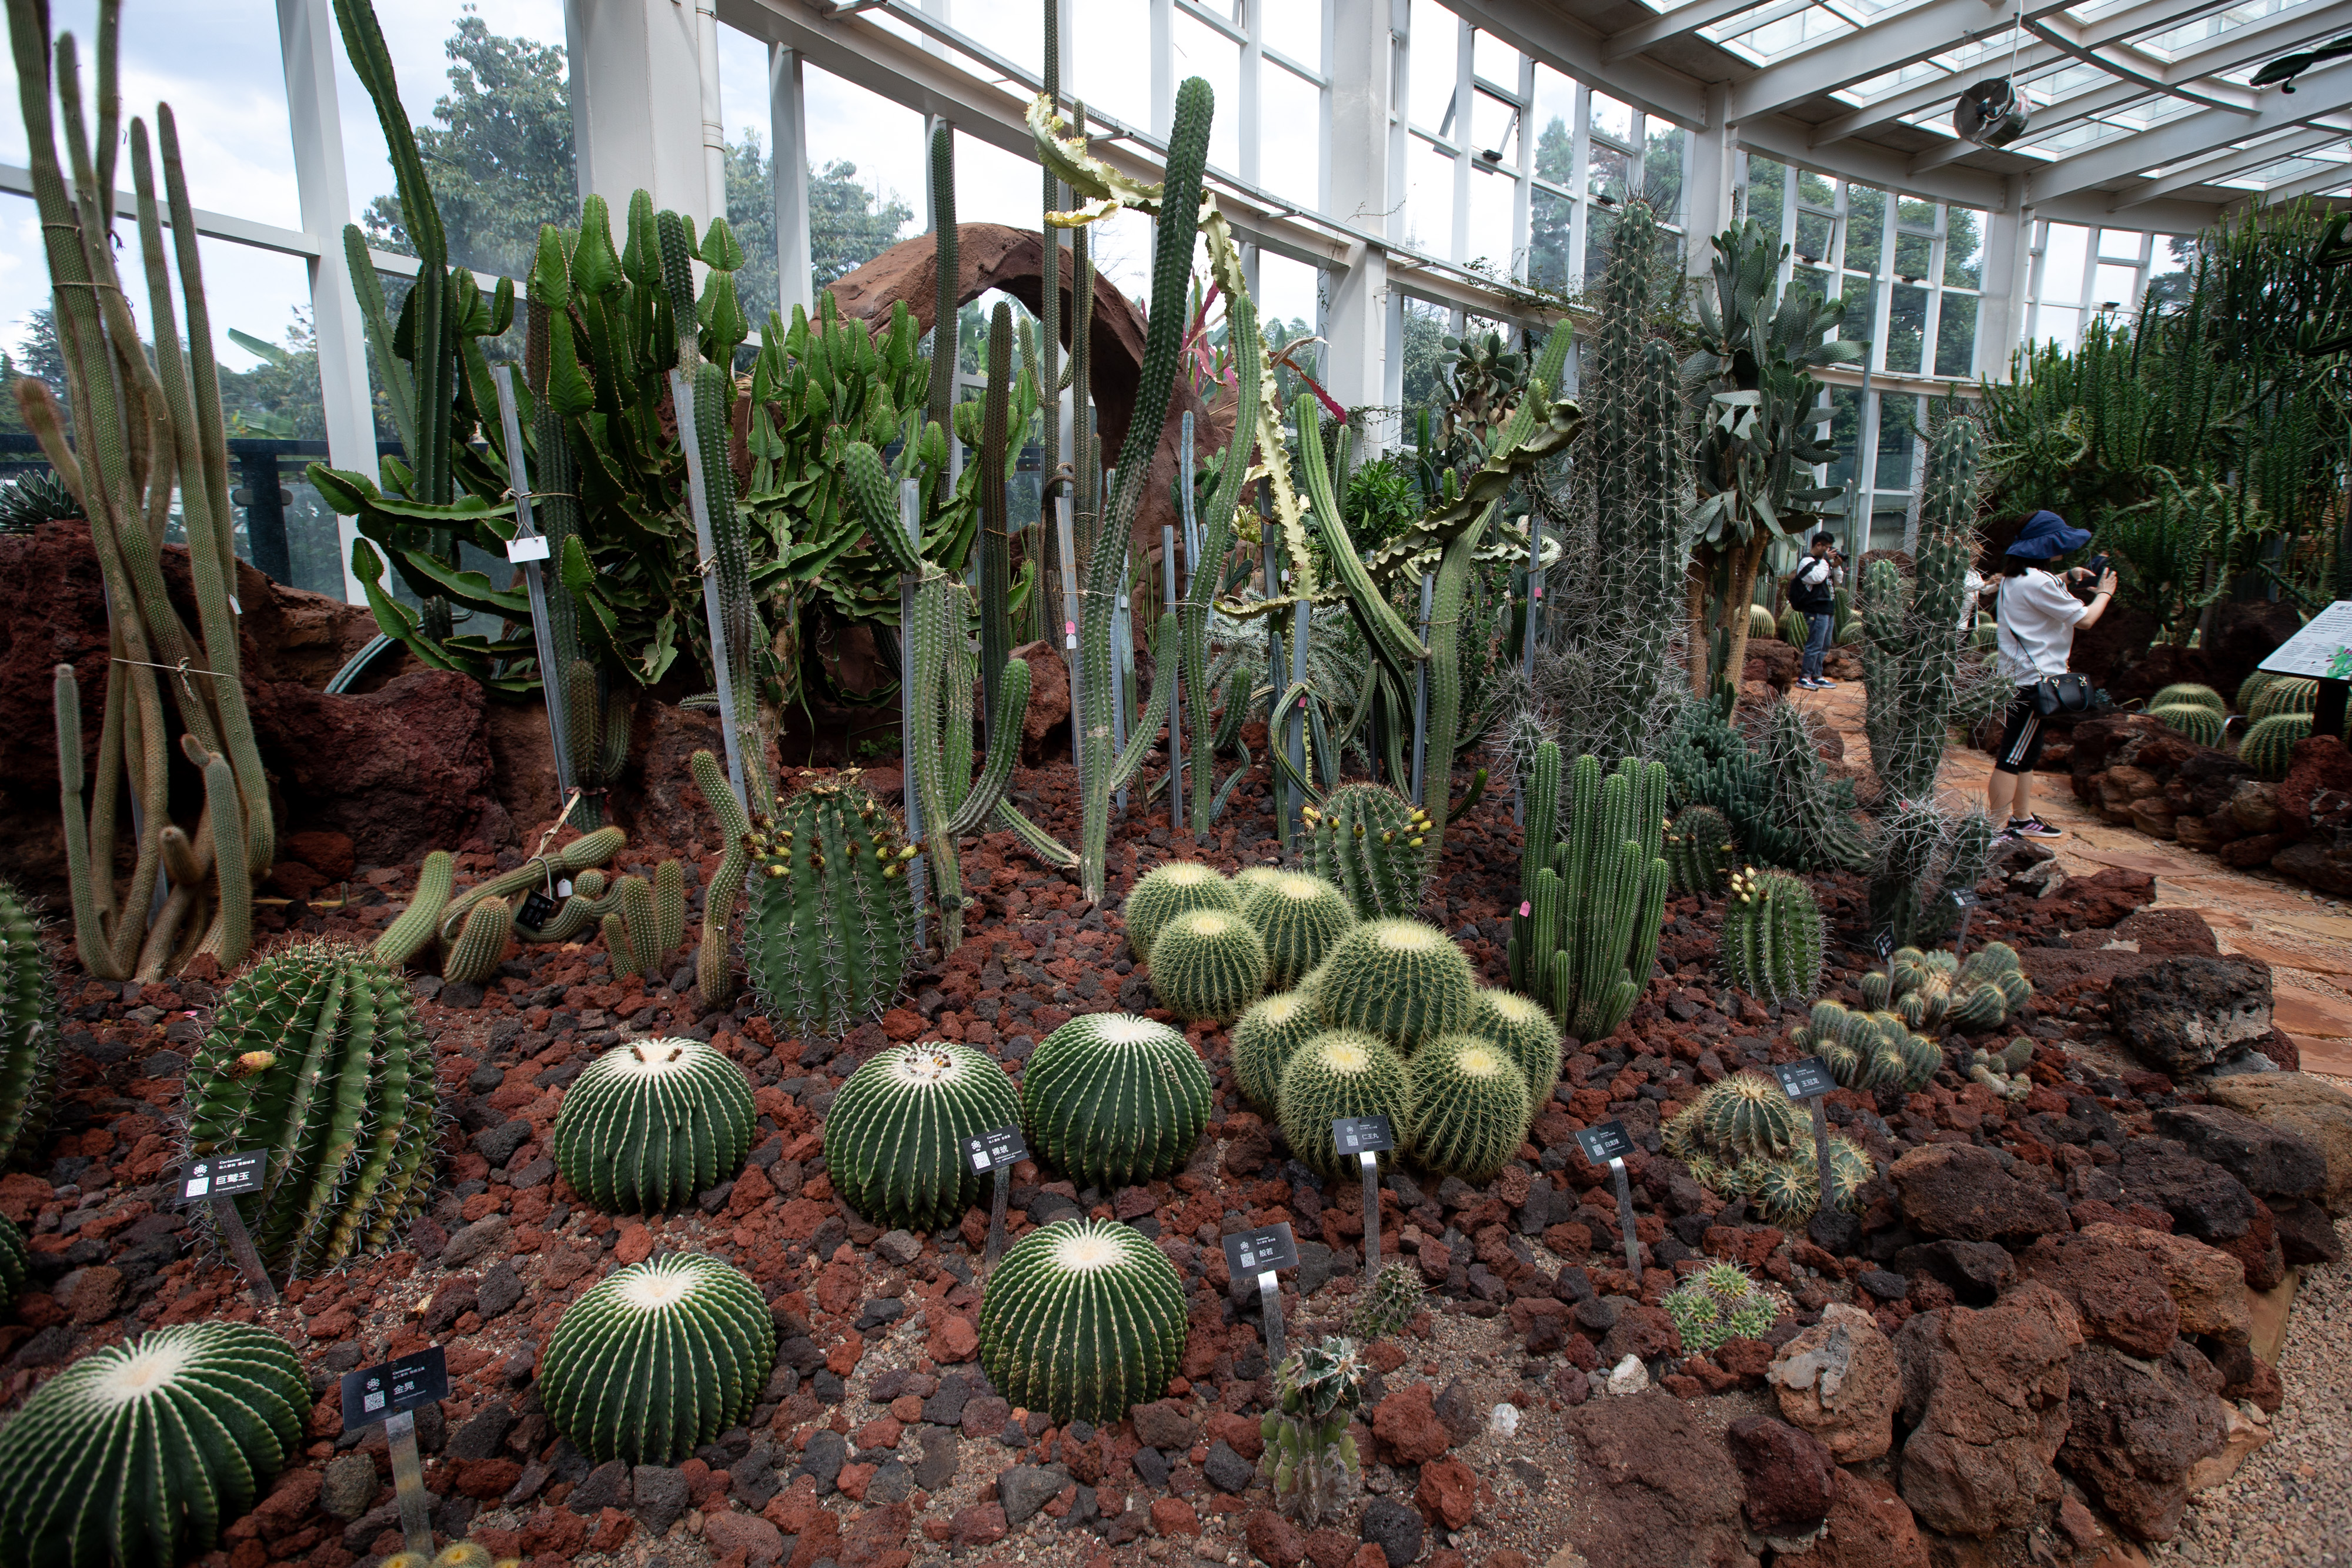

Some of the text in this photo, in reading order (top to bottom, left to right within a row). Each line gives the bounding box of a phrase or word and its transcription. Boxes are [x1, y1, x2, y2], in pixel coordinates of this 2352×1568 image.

[1801, 1078, 1819, 1087] 王冠龙
[1605, 1139, 1619, 1148] 白龙球
[992, 1145, 1008, 1156] 裸琥
[216, 1172, 249, 1185] 巨鹫玉
[1259, 1248, 1273, 1257] 般若
[394, 1381, 415, 1395] 金晃
